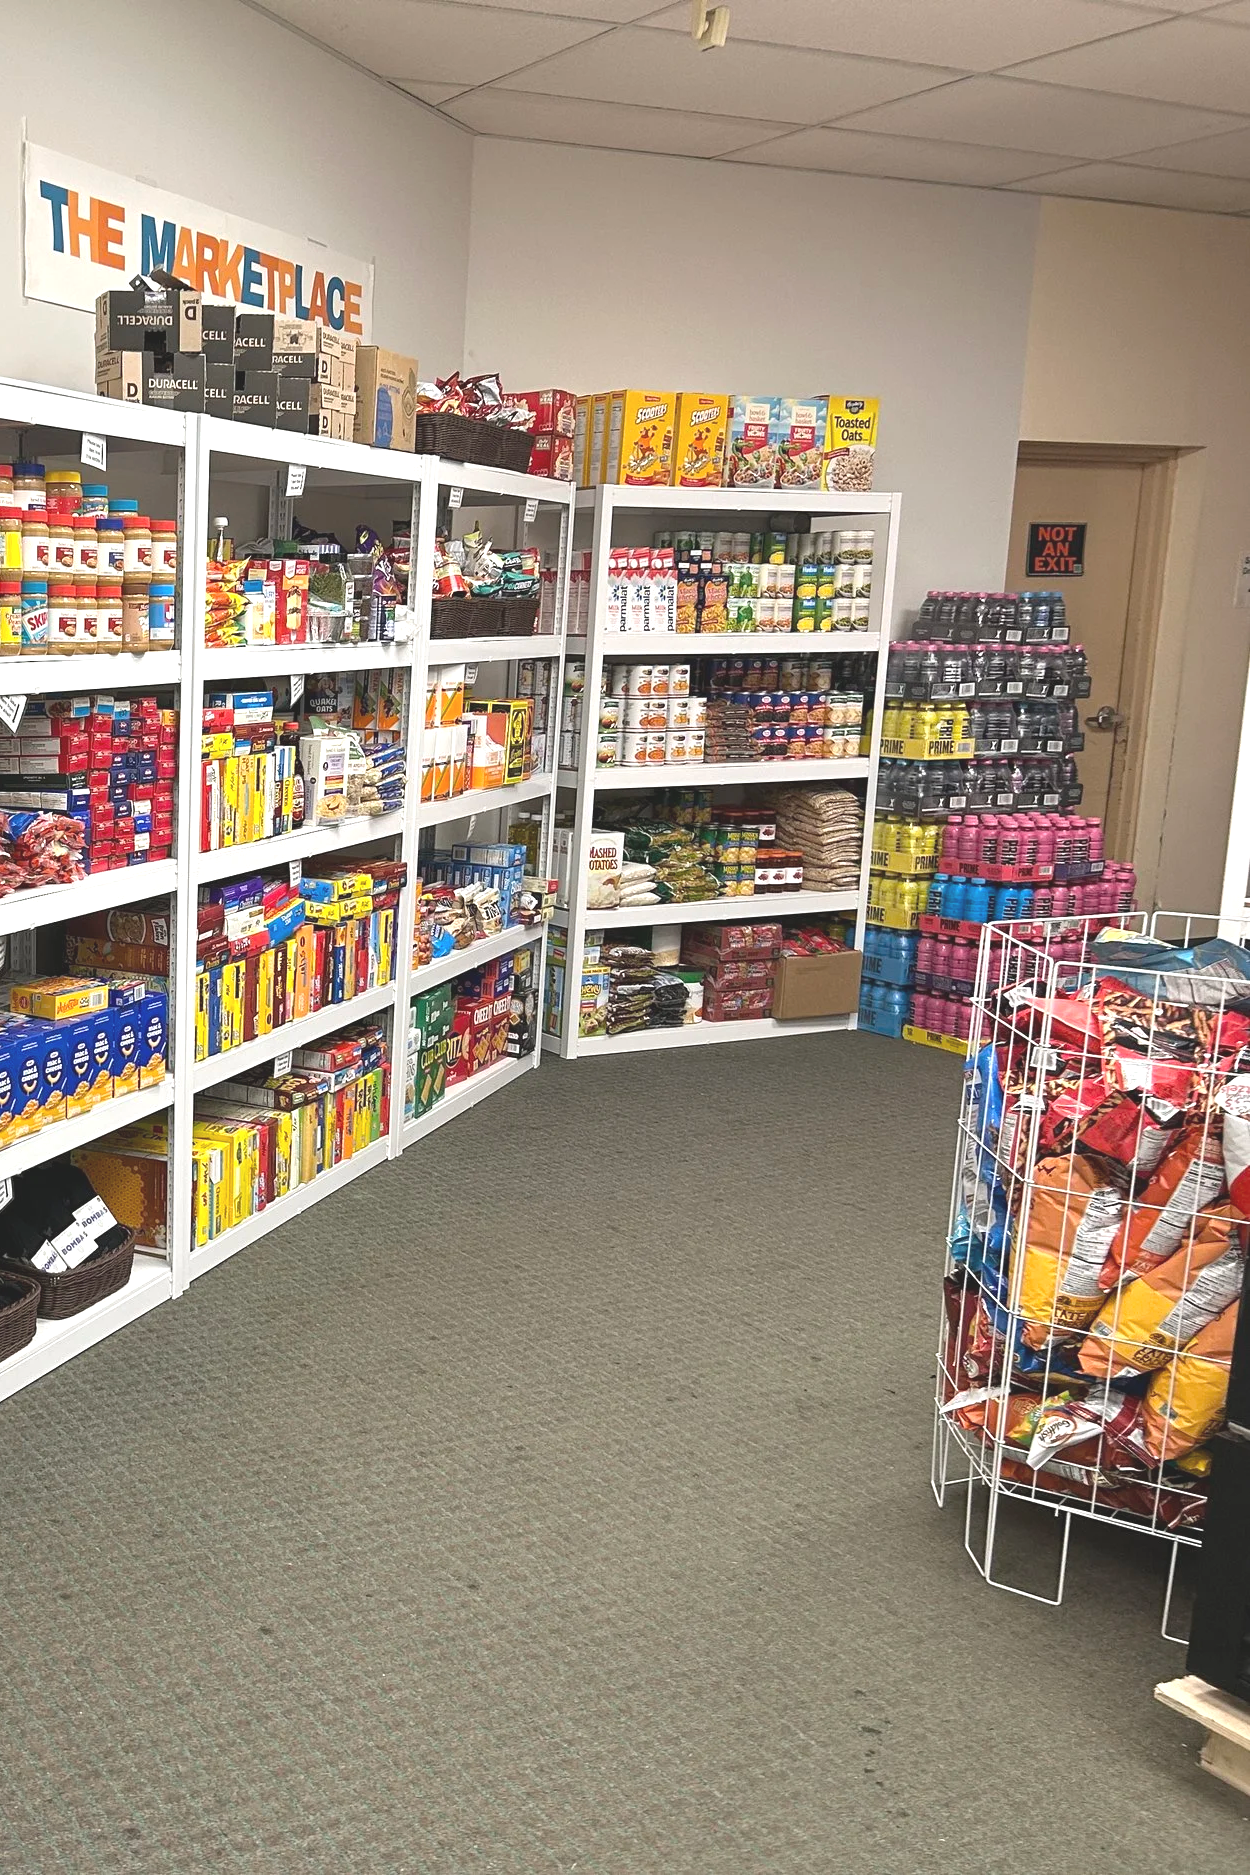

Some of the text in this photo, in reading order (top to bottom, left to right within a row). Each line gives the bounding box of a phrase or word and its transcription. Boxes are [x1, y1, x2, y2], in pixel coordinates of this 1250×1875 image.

[40, 180, 363, 335] THE MARKETPLACE
[117, 315, 172, 326] DURACELL
[127, 383, 138, 397] D
[149, 378, 198, 390] DURACELL
[635, 403, 668, 424] SCOOTERS
[690, 407, 720, 426] SCOOTERS
[834, 416, 871, 429] Toasted
[841, 430, 863, 442] Oats
[1038, 527, 1077, 541] NOT
[1042, 542, 1069, 556] AN
[1034, 557, 1077, 571] EXIT
[619, 585, 627, 632] parmalat
[643, 585, 651, 632] parmalat
[667, 585, 675, 632] parmalat
[316, 705, 333, 713] OATS
[929, 740, 954, 754] PRIME
[915, 855, 939, 870] PRIME
[959, 863, 979, 875] PRIME
[1018, 867, 1033, 877] PRIME
[940, 918, 960, 931] PRIME
[927, 1031, 942, 1044] PRIME
[446, 1035, 462, 1062] RITZ
[421, 1049, 434, 1070] CLUB
[81, 1206, 108, 1228] BOMBAS
[62, 1231, 88, 1256] BOMBAS
